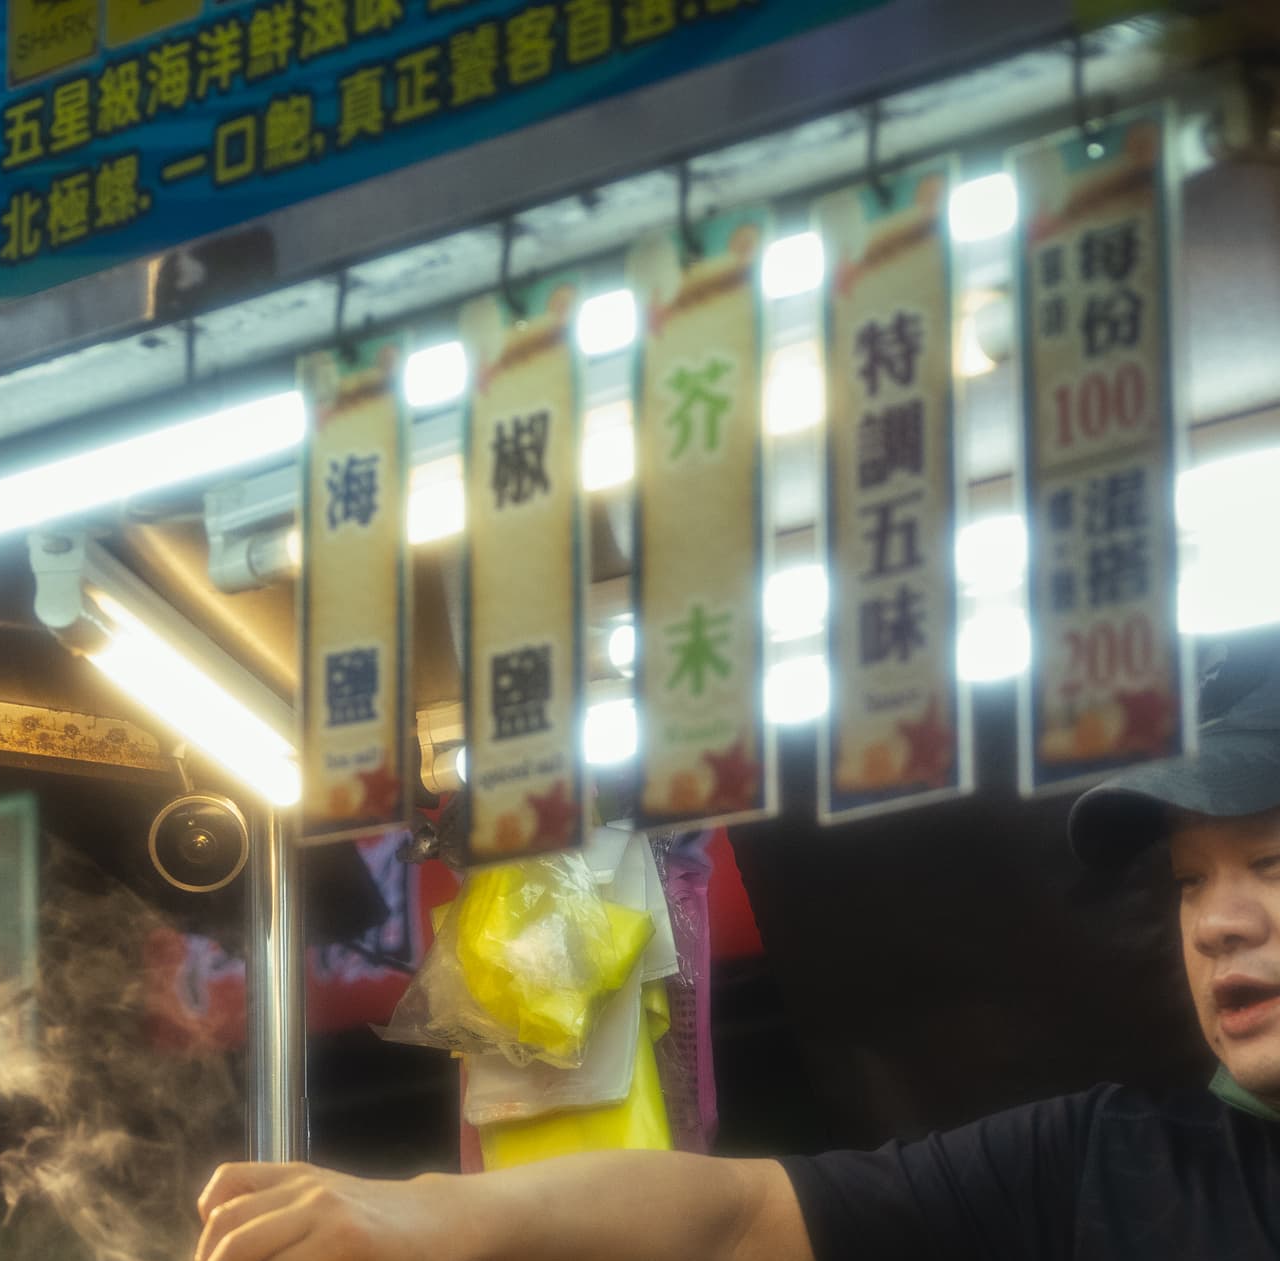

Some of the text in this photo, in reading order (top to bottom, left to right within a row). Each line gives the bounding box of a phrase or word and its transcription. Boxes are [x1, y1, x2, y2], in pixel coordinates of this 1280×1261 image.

[1055, 362, 1148, 447] 100
[1080, 221, 1145, 357] 每份
[325, 453, 381, 727] 海鹽
[490, 409, 554, 741] 椒鹽
[665, 359, 732, 697] 芥末
[854, 311, 926, 666] 特調五味
[1062, 612, 1154, 694] 200
